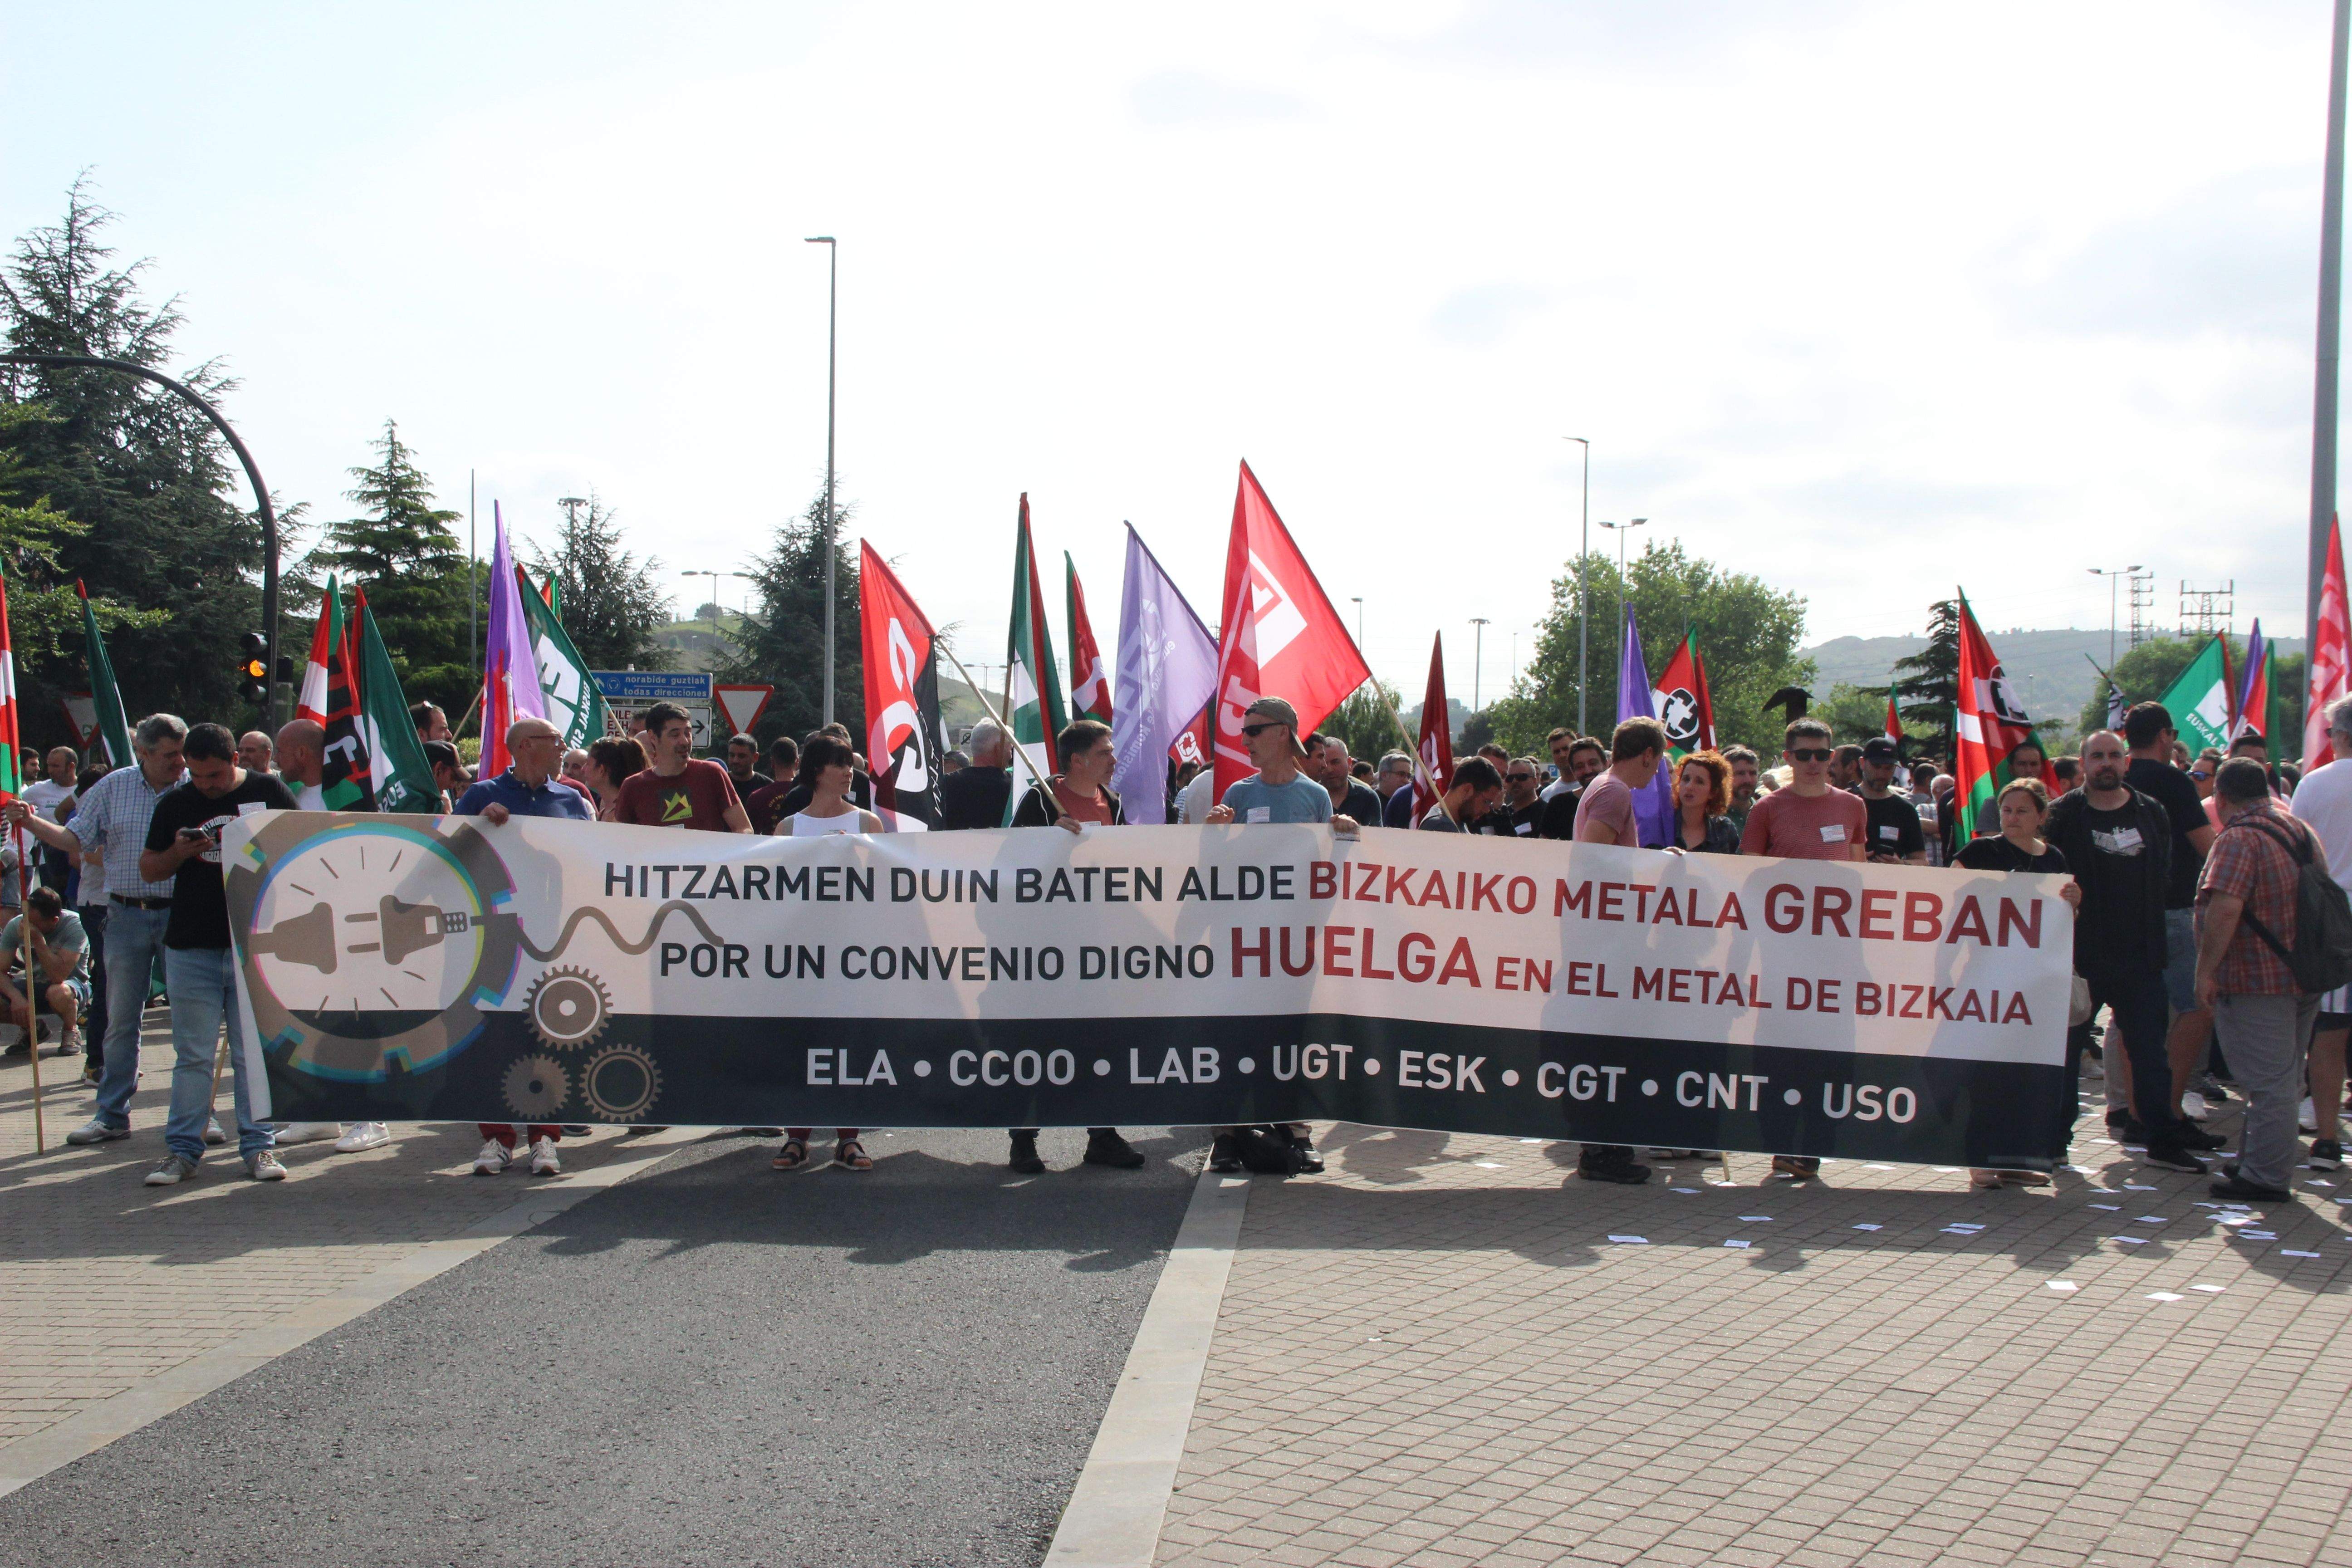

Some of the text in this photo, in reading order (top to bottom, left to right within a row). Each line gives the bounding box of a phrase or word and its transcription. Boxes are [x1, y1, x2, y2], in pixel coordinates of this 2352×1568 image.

[623, 687, 707, 697] todas direcciones
[626, 676, 706, 686] norabide guztiak
[2185, 713, 2219, 745] EUSKAL
[606, 861, 2042, 949] HITZARMEN DUIN BATEN ALDE BIZKAIKO METALA GREBAN
[662, 926, 2033, 1026] POR UN CONVENIO DIGNO HUELGA EN EL METAL DE BIZKAIA
[808, 1044, 1916, 1123] ELA CCOO LAB UGT ESK CGT CNT USO
